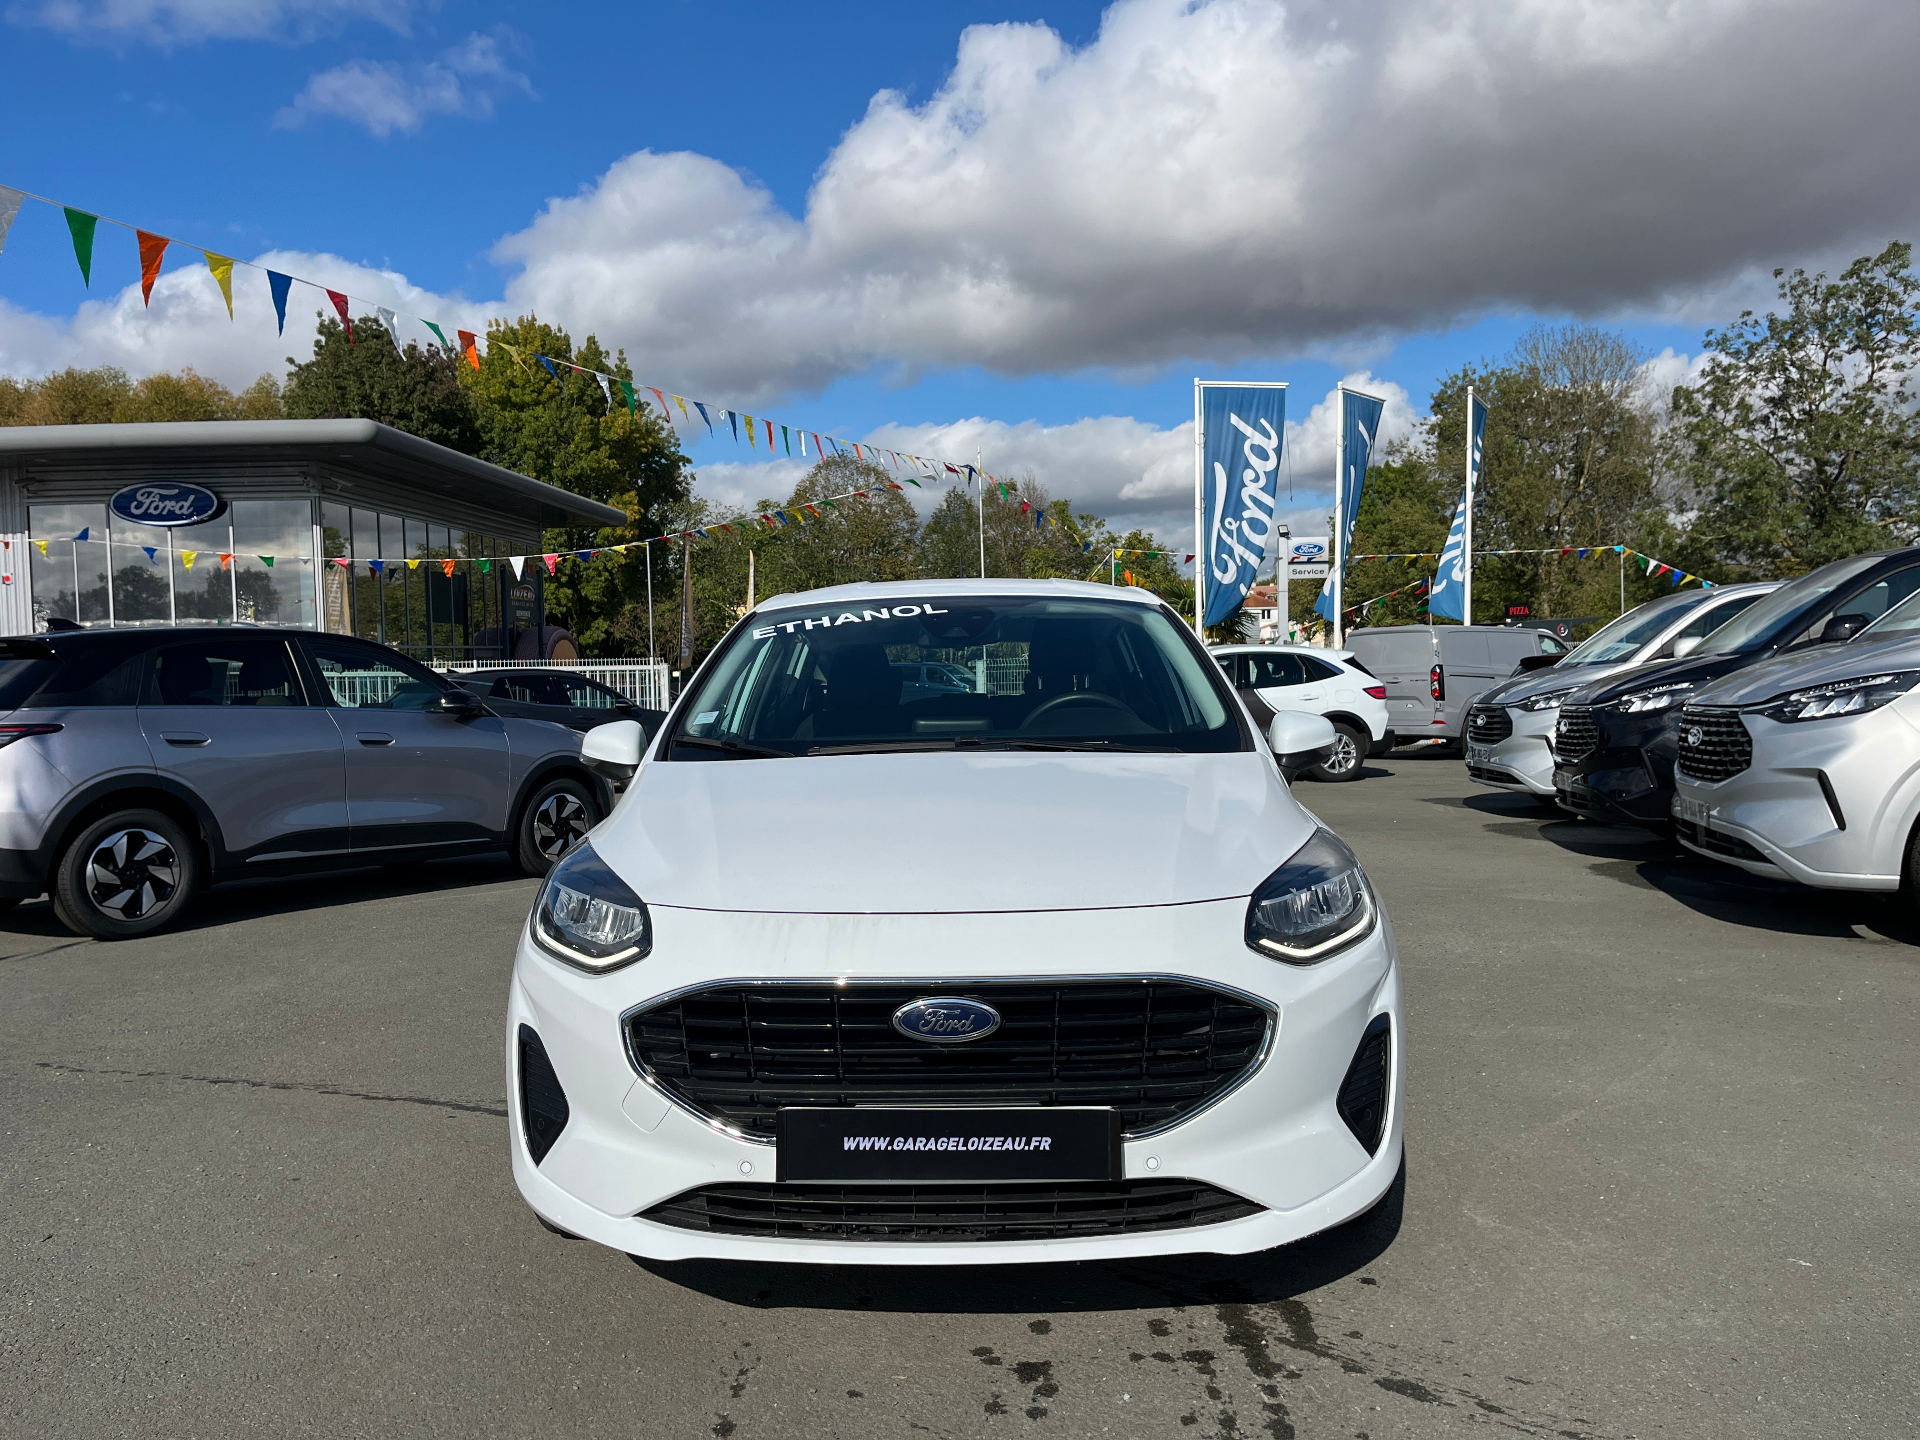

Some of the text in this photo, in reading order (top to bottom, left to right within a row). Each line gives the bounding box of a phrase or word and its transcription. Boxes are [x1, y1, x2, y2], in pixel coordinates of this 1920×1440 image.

[130, 487, 196, 515] Ford
[1211, 412, 1279, 597] Ford
[1298, 544, 1319, 553] Ford
[752, 603, 949, 640] ETHANOL
[1509, 606, 1530, 616] PIZZA
[918, 1008, 975, 1032] Ford
[843, 1136, 1052, 1151] WWW.GARAGELOIZEAU.FR
